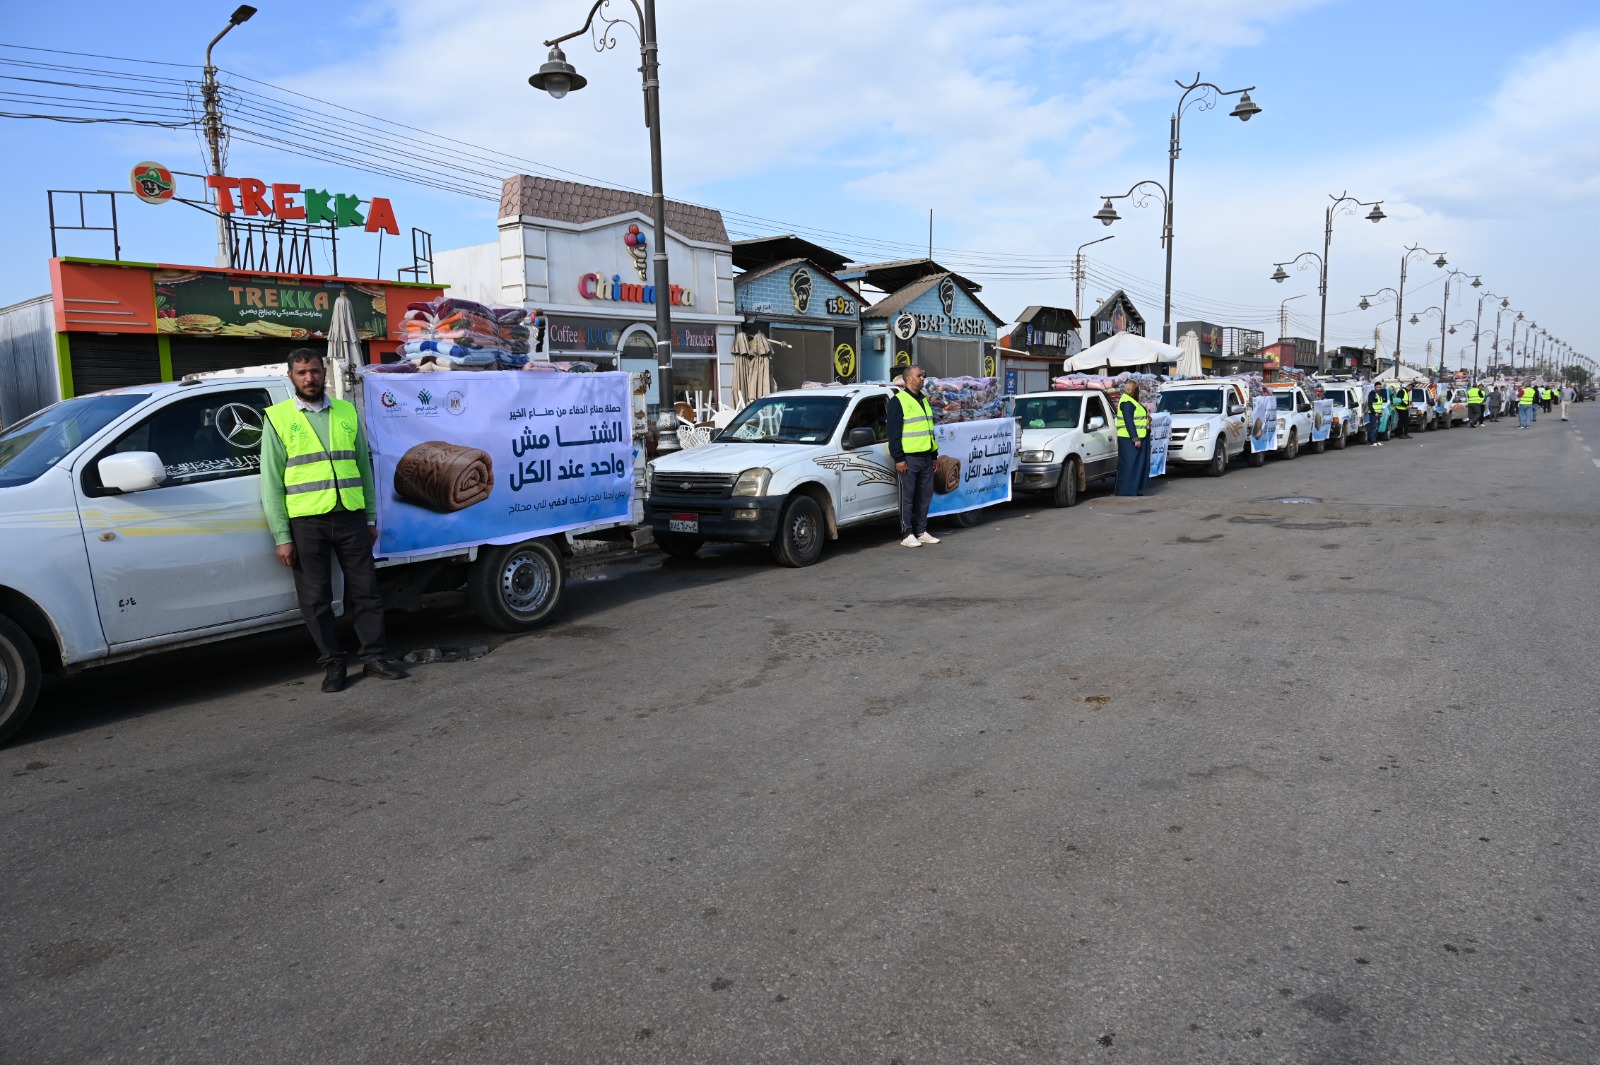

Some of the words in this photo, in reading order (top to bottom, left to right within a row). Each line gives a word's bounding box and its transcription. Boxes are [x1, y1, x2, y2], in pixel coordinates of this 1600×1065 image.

[208, 175, 400, 235] TREKKA
[229, 286, 328, 311] TREKKA
[829, 296, 855, 315] 15928
[949, 317, 988, 336] PASHA
[509, 408, 527, 420] الخير
[556, 407, 567, 417] من
[590, 405, 604, 416] صناع
[604, 404, 621, 413] حملة
[512, 426, 550, 458] مش
[968, 445, 984, 463] مش
[558, 459, 585, 480] عند
[591, 452, 625, 478] واحد
[965, 464, 981, 482] الكل
[982, 464, 993, 476] عند
[994, 460, 1009, 475] واحد
[509, 459, 551, 492] الكل
[508, 503, 532, 515] محتاج
